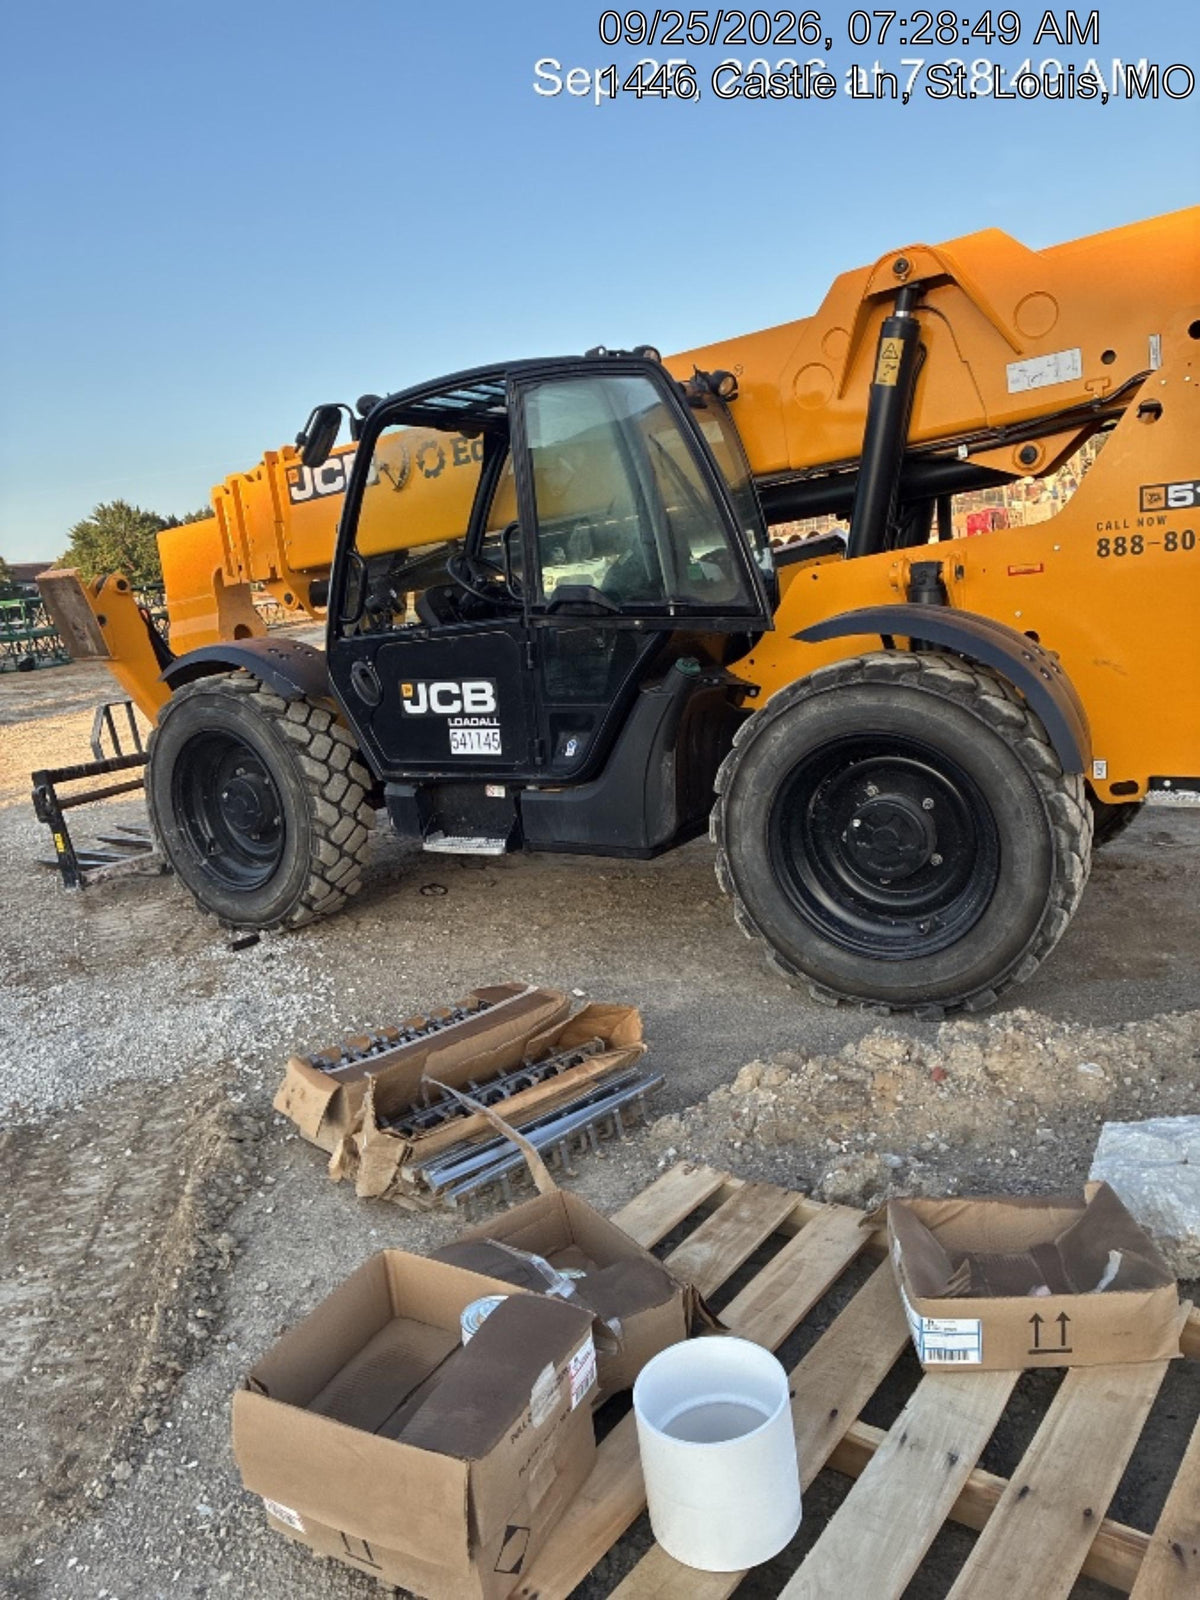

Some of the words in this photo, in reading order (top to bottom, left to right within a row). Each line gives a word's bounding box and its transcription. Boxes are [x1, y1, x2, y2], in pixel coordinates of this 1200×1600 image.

[1167, 482, 1200, 508] 5
[1096, 520, 1130, 532] CALL
[1137, 515, 1168, 528] NOW
[402, 681, 497, 714] JCB
[447, 717, 501, 727] LOADALL
